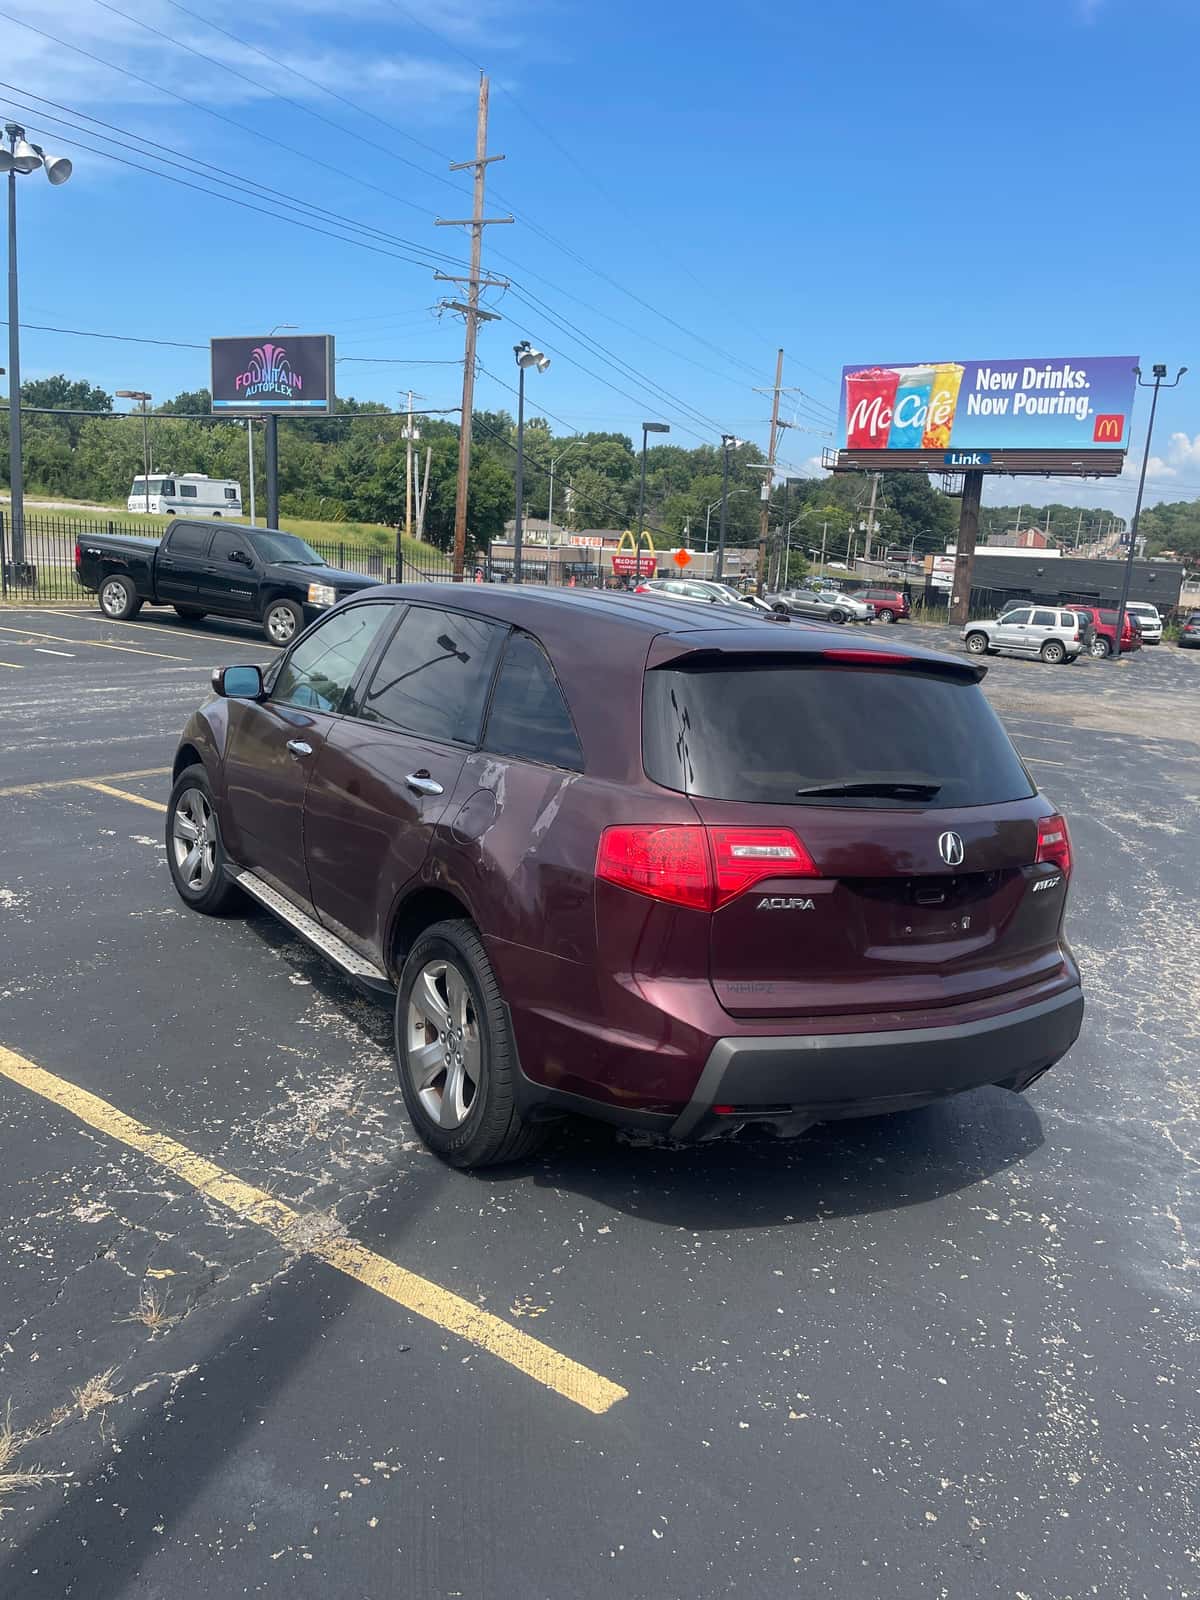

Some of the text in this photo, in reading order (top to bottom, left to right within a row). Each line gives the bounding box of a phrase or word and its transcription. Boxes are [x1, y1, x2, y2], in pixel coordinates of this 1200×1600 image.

[235, 368, 303, 391] FOUNTAIN
[976, 365, 1091, 391] New Drinks.
[244, 383, 293, 398] AUTOPLEX
[966, 390, 1094, 421] Now Pouring.
[951, 453, 982, 466] Link
[756, 897, 816, 910] ACURA
